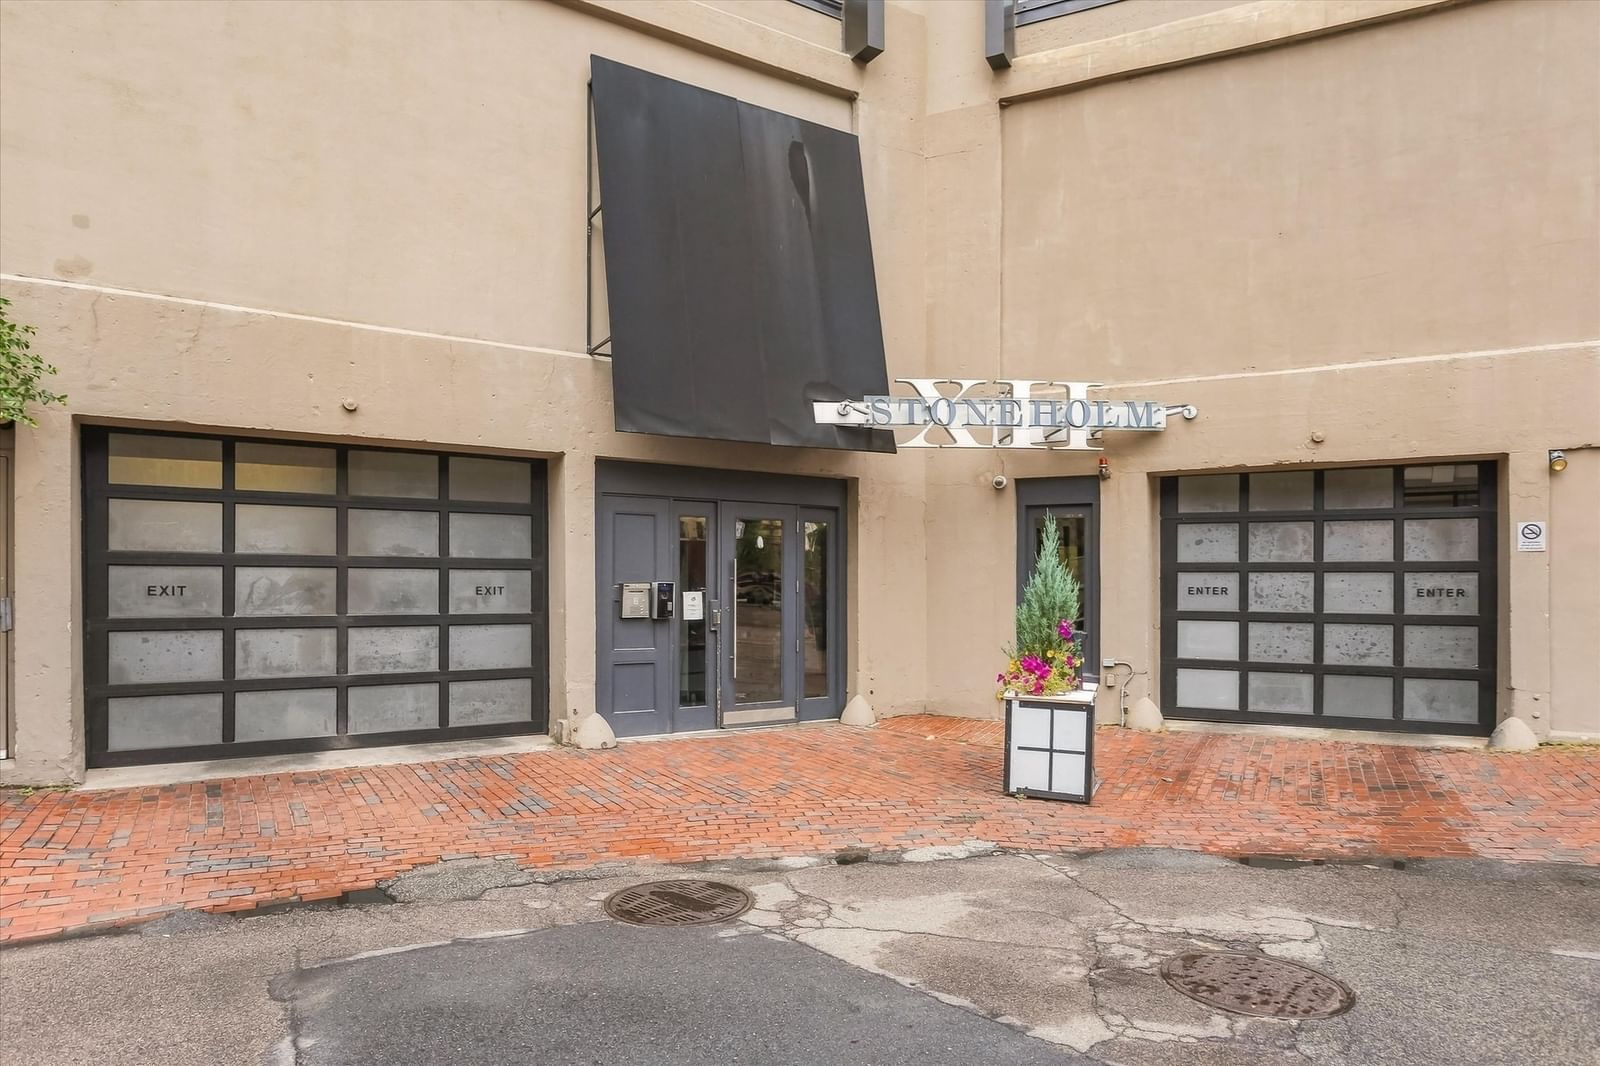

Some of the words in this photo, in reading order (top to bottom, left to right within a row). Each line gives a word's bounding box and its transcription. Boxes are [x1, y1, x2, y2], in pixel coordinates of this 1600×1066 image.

[870, 397, 1155, 428] STONEHOLM
[147, 585, 187, 597] EXIT
[475, 585, 505, 596] EXIT
[1187, 586, 1229, 596] ENTER
[1416, 587, 1466, 598] ENTER
